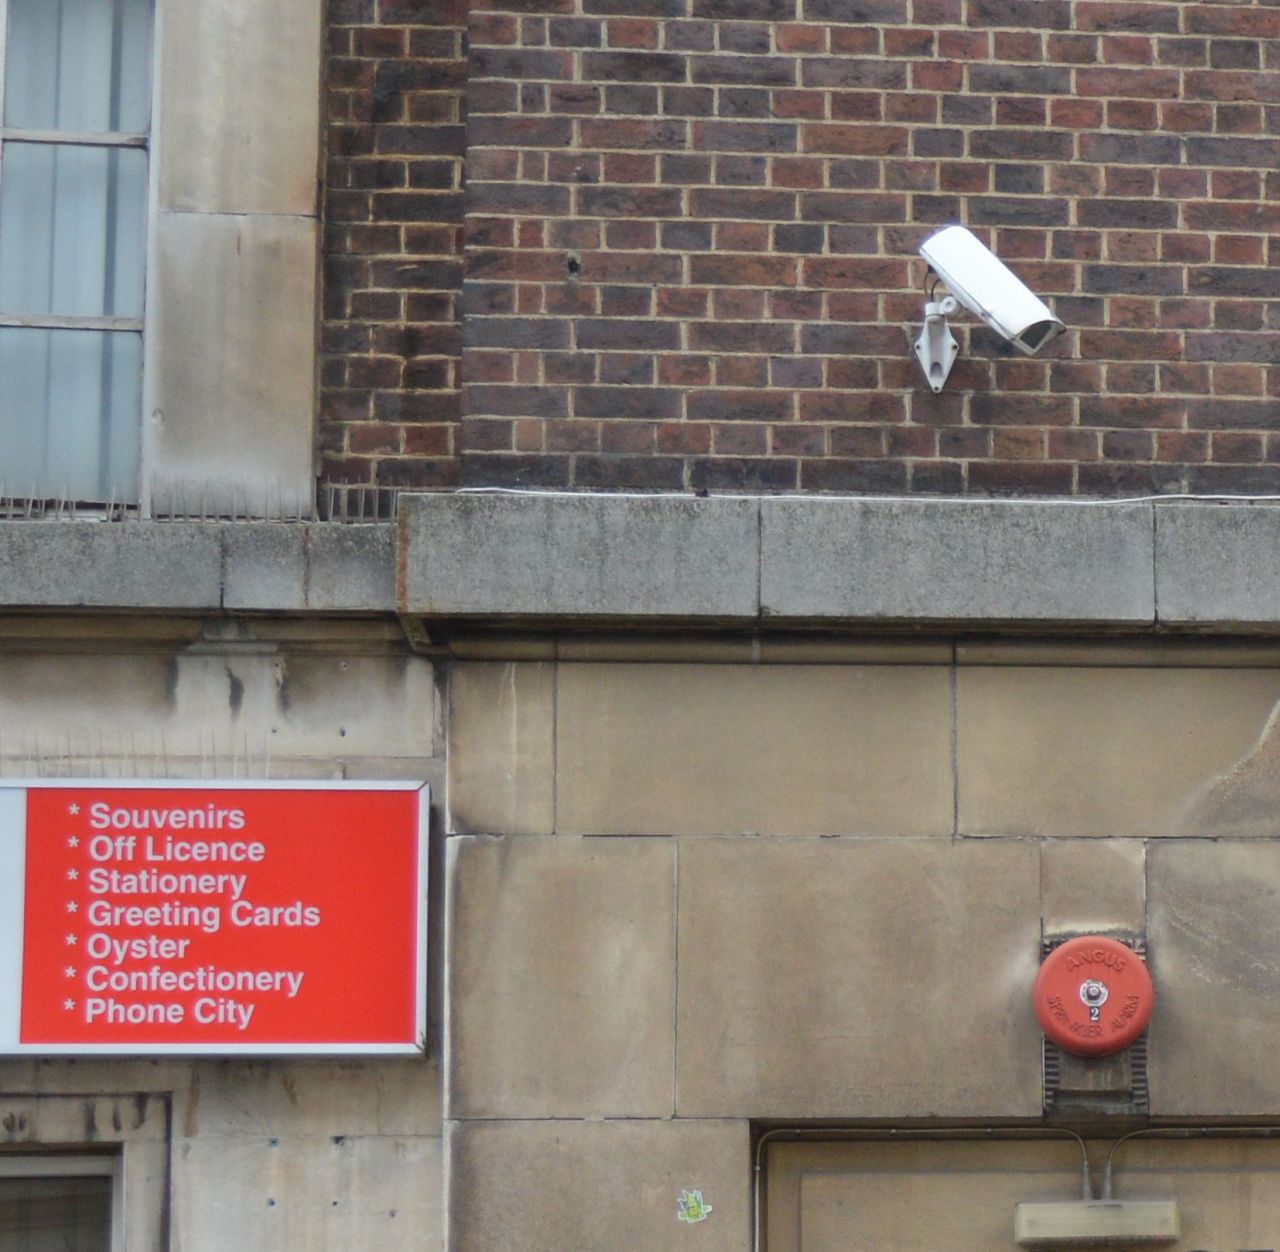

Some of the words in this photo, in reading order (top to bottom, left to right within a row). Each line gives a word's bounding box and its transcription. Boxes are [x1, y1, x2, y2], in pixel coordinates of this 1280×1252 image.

[90, 803, 246, 829] Souvenirs
[89, 835, 136, 862] Off
[146, 836, 265, 862] Licence
[89, 867, 247, 900] Stationery
[88, 900, 221, 933] Greeting
[230, 901, 321, 927] Cards
[87, 933, 190, 965] Oyster
[1066, 951, 1127, 973] ANGUS
[86, 965, 304, 997] Confectionery
[86, 998, 184, 1024] Phone
[194, 998, 255, 1030] City
[1090, 1007, 1099, 1021] 2
